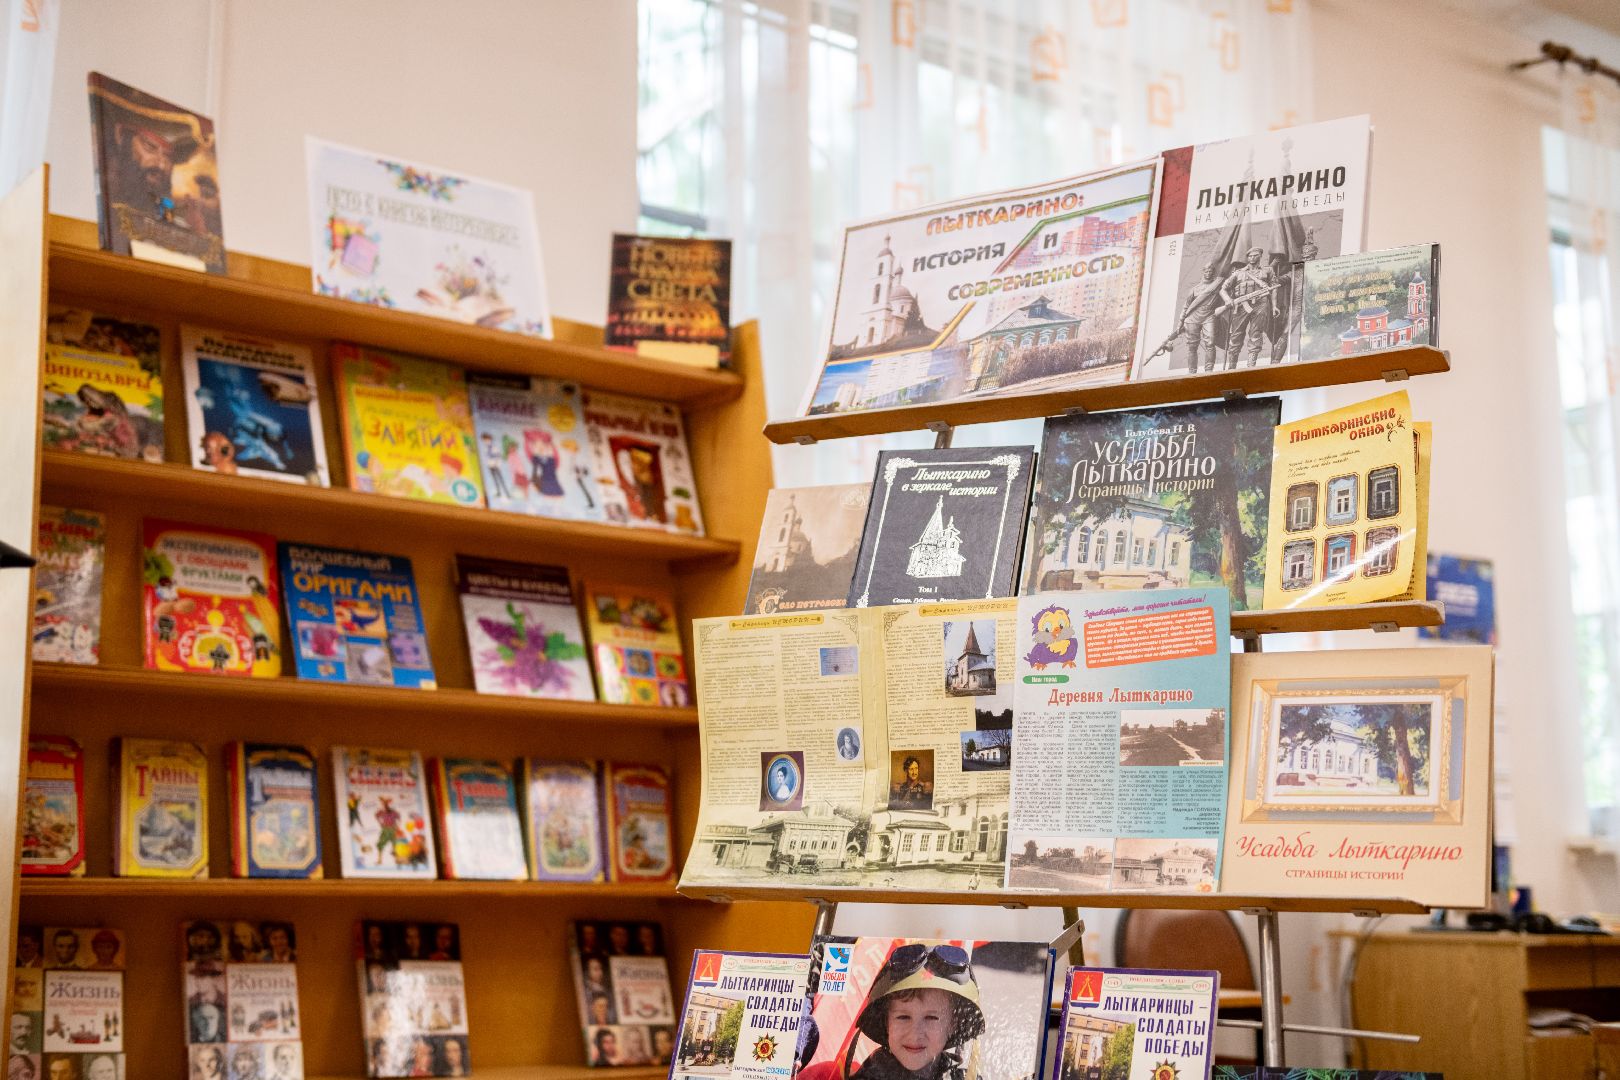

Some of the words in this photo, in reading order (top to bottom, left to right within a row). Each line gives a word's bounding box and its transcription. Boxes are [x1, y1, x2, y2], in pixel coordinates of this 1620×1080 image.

[1195, 165, 1346, 210] ЛЫТКАРИНО
[926, 192, 1084, 236] ЛЫТКАРИНО:
[1195, 212, 1213, 225] НА
[1223, 203, 1270, 221] КАРТЕ
[1279, 192, 1346, 211] ПОБЕДЫ
[912, 241, 1006, 273] ИСТОРИЯ
[1043, 232, 1058, 249] И
[947, 253, 1126, 302] СОВРЕМЕННОСТЬ
[1124, 426, 1171, 439] Голубева
[1174, 424, 1185, 436] Н.
[1187, 423, 1198, 434] В.
[1289, 407, 1397, 445] Лыткаринские
[1349, 423, 1385, 442] окна
[1091, 432, 1198, 465] УСАДЬБА
[911, 467, 991, 482] Лыткарино
[1065, 454, 1217, 504] Лыткарино
[910, 481, 953, 494] зеркале
[949, 485, 999, 498] истории
[1077, 482, 1147, 499] Страницы
[1155, 478, 1215, 493] истории
[293, 571, 414, 604] ОРИГАМИ
[1048, 688, 1103, 706] Деревня
[1109, 688, 1193, 704] Лыткарино
[1236, 831, 1318, 859] Усадьба
[1328, 837, 1463, 870] Лыткарино
[1285, 869, 1347, 880] СТРАНИЦЫ
[1350, 871, 1404, 881] ИСТОРИИ
[49, 981, 121, 1000] Жизнь
[720, 976, 795, 995] ЛЫТКАРИНЦЫ
[823, 980, 831, 992] 70
[831, 981, 846, 993] ЛЕТ
[746, 995, 803, 1013] СОЛДАТЫ
[1103, 996, 1194, 1017] ЛЫТКАРИНЦЫ
[750, 1014, 800, 1032] ПОБЕДЫ
[1137, 1018, 1206, 1036] СОЛДАТЫ
[1144, 1038, 1204, 1058] ПОБЕДЫ
